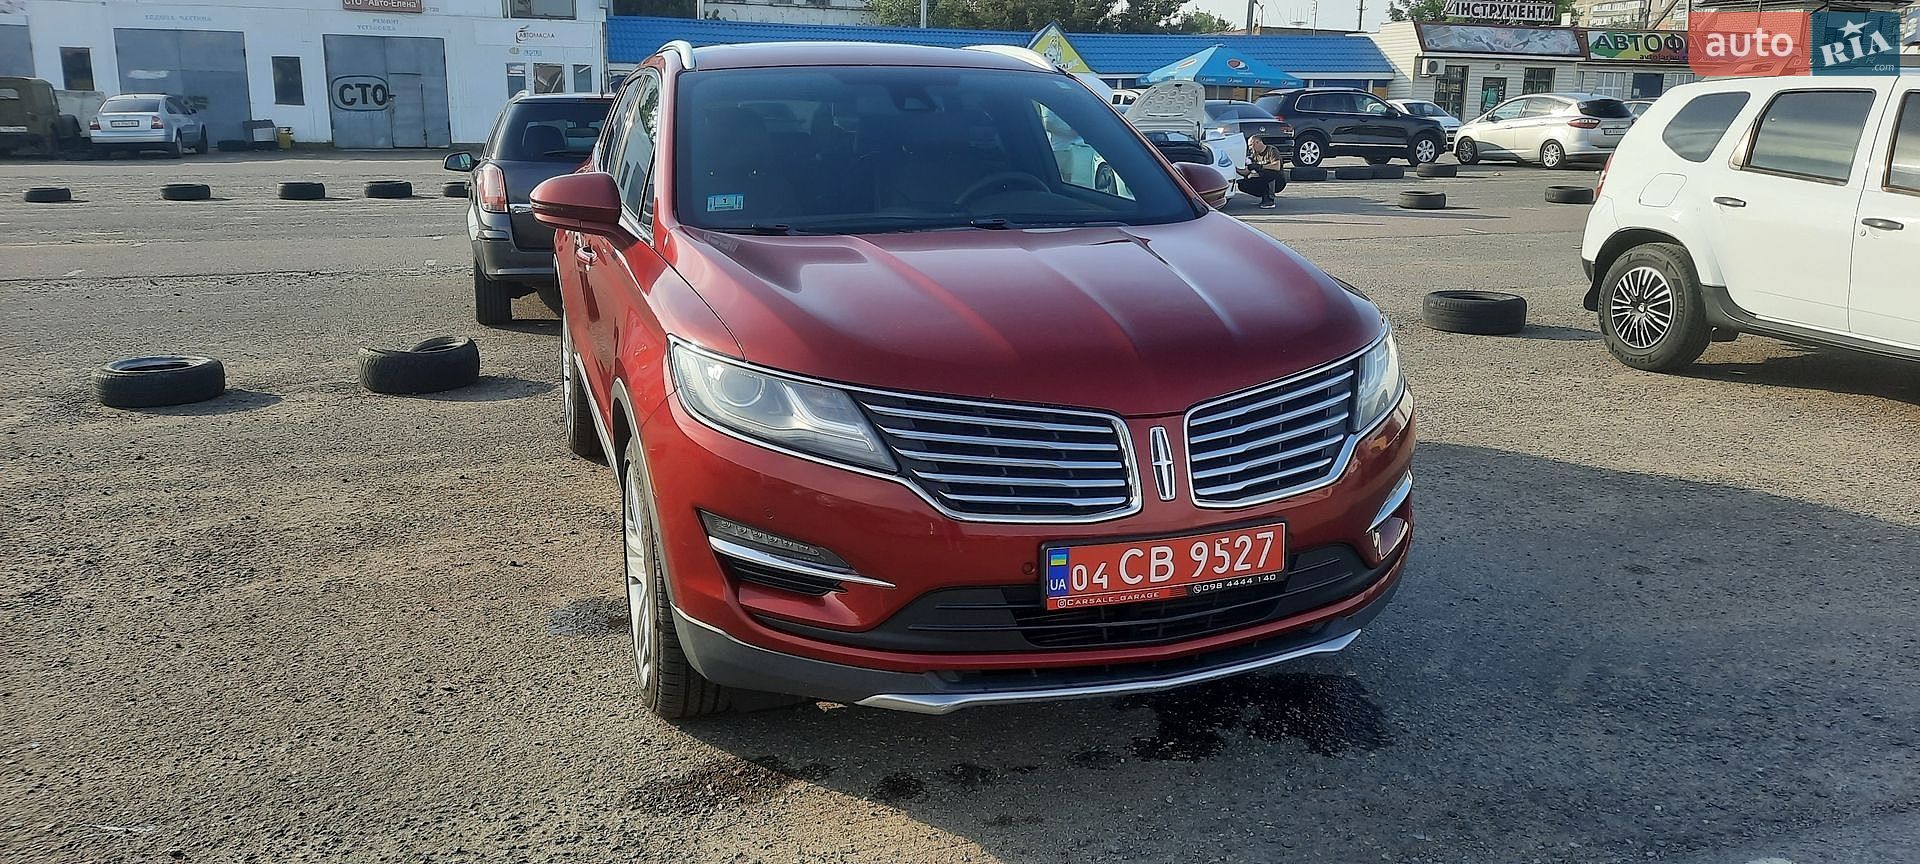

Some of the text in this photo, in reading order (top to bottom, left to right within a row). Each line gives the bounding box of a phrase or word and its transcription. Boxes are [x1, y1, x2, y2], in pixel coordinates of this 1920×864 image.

[1455, 2, 1555, 20] ІНСТРУМЕНТИ
[339, 83, 387, 106] СТО
[1072, 531, 1274, 591] 04 CB 9527
[1050, 578, 1067, 591] UA
[1202, 574, 1277, 592] 098 4444 140
